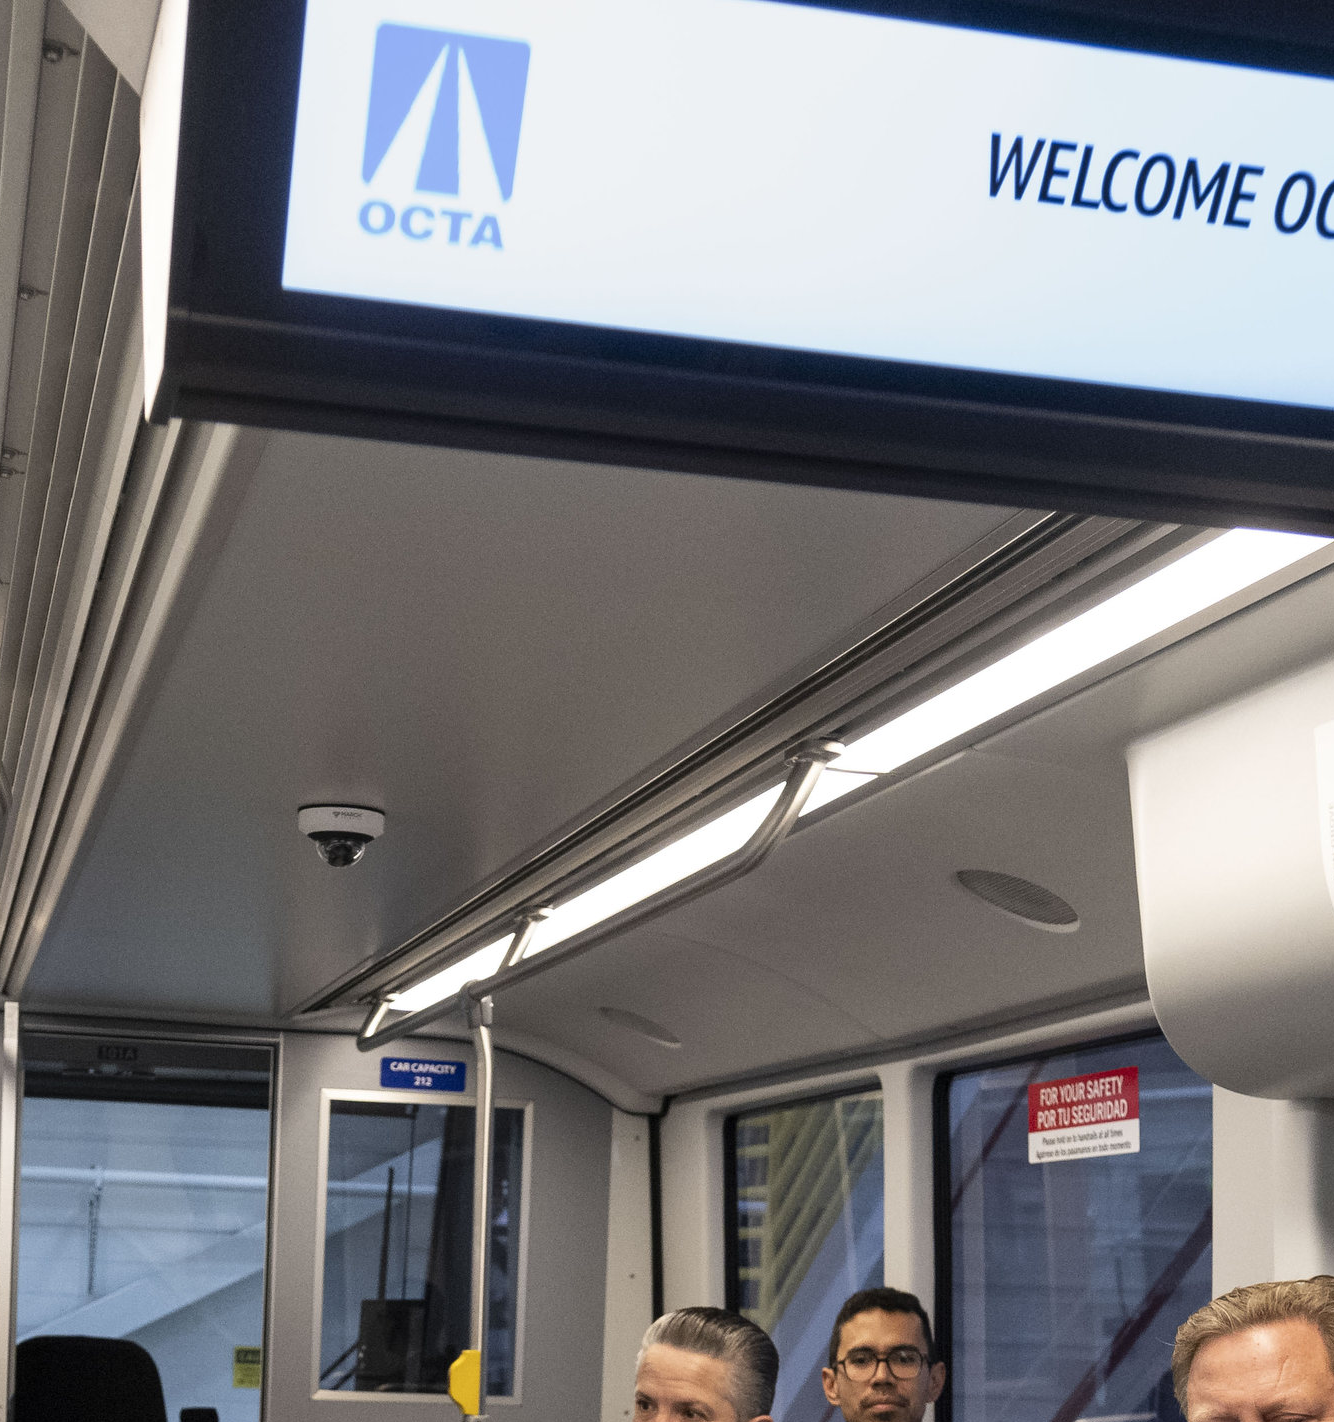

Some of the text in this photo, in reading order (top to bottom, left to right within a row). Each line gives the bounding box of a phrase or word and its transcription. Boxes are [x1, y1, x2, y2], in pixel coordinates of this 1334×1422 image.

[989, 131, 1265, 229] WELCOME
[358, 200, 503, 250] OCTA
[390, 1061, 457, 1074] CAR CAPACITY
[414, 1076, 433, 1087] 212
[1040, 1075, 1123, 1107] FOR YOUR SAFETY
[1037, 1099, 1129, 1130] POR TU SEGURIDAD
